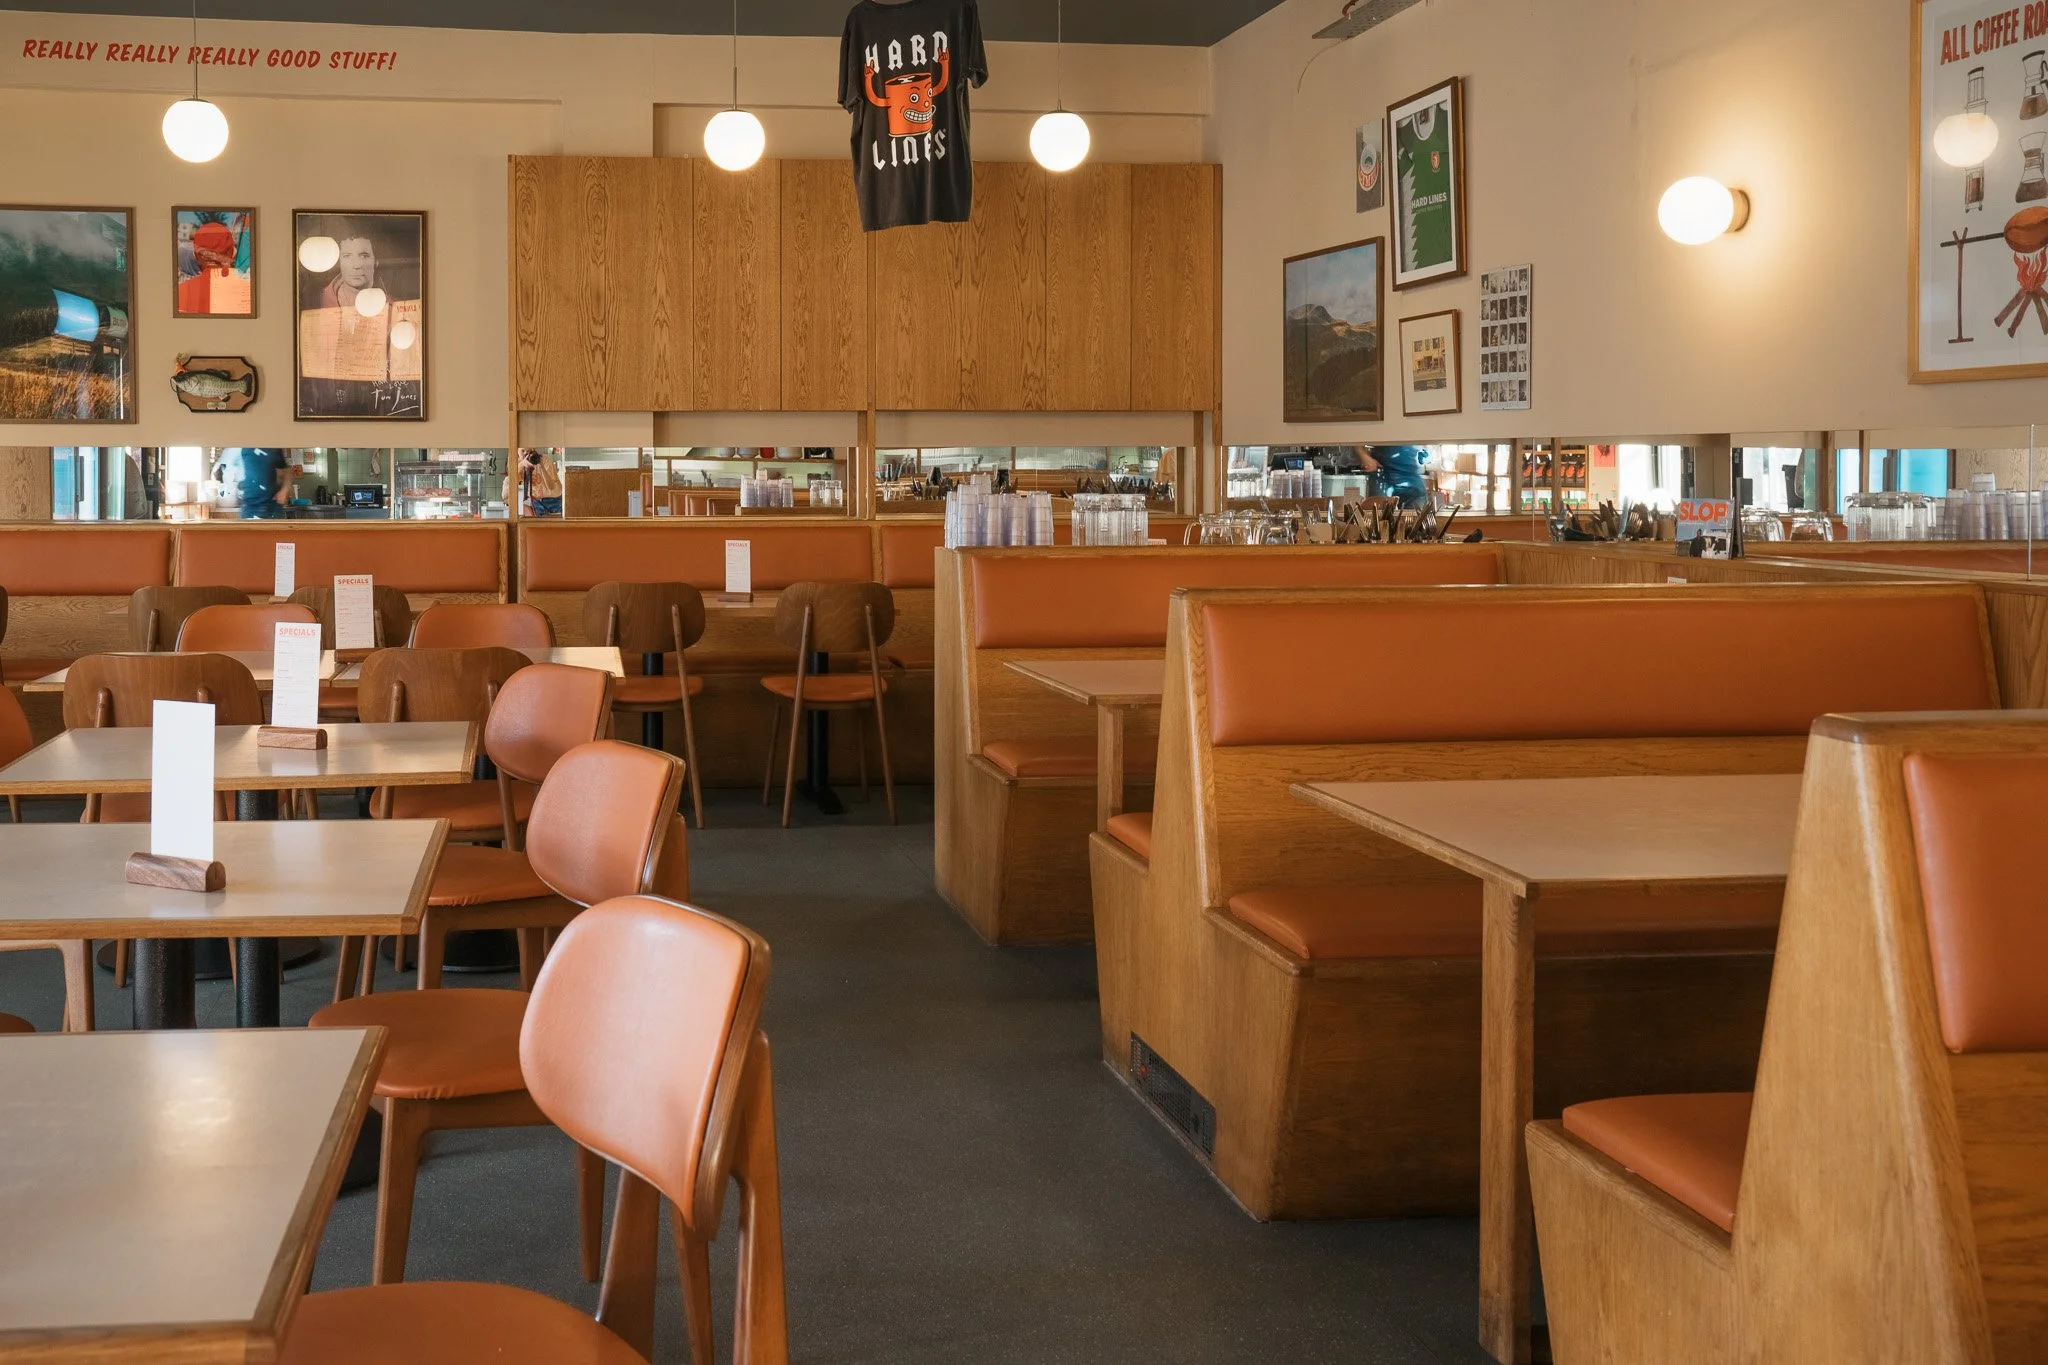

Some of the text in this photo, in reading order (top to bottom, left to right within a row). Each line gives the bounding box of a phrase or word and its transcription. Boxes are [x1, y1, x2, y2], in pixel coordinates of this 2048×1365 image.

[1940, 25, 1970, 65] ALL
[1973, 8, 2019, 55] COFFEE
[23, 39, 397, 71] REALLY REALLY REALLY GOOD STUFF!
[865, 31, 950, 73] HARD
[872, 130, 946, 170] LINES
[1412, 196, 1428, 210] HARD
[1428, 192, 1447, 205] LINES
[1679, 501, 1728, 522] SLOP
[337, 578, 370, 586] SPECIALS
[279, 628, 316, 637] SPECIALS
